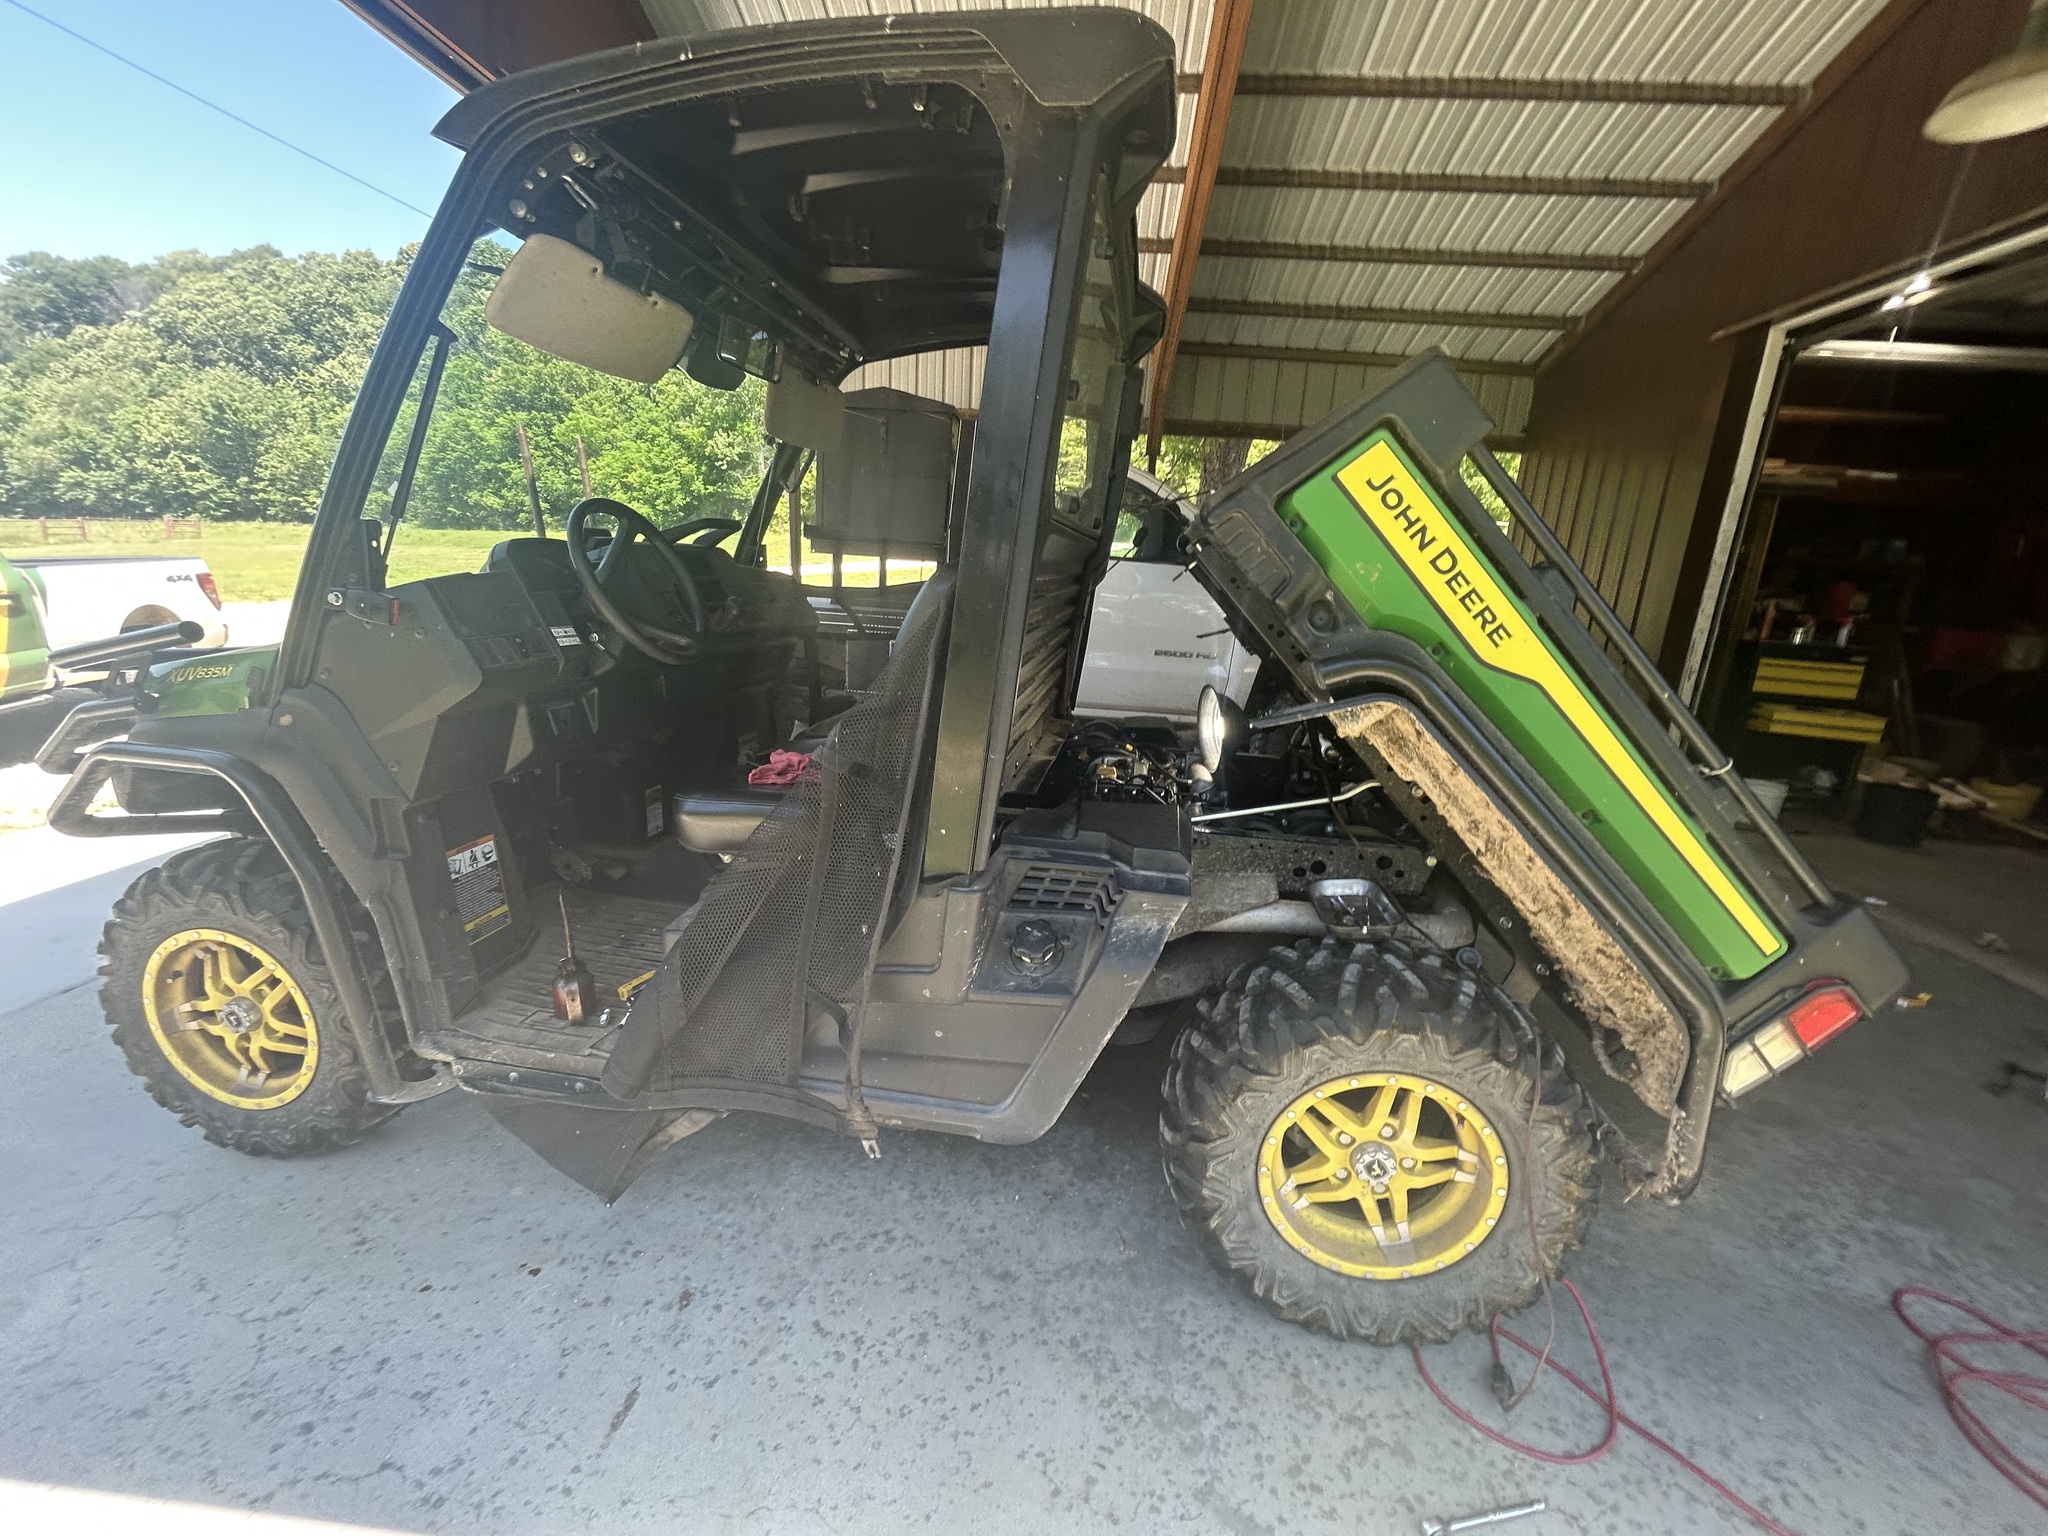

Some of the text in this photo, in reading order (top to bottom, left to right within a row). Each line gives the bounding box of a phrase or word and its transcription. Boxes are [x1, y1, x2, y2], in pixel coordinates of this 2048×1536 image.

[1365, 474, 1513, 649] JOHN DEERE
[167, 666, 234, 682] XUV835M
